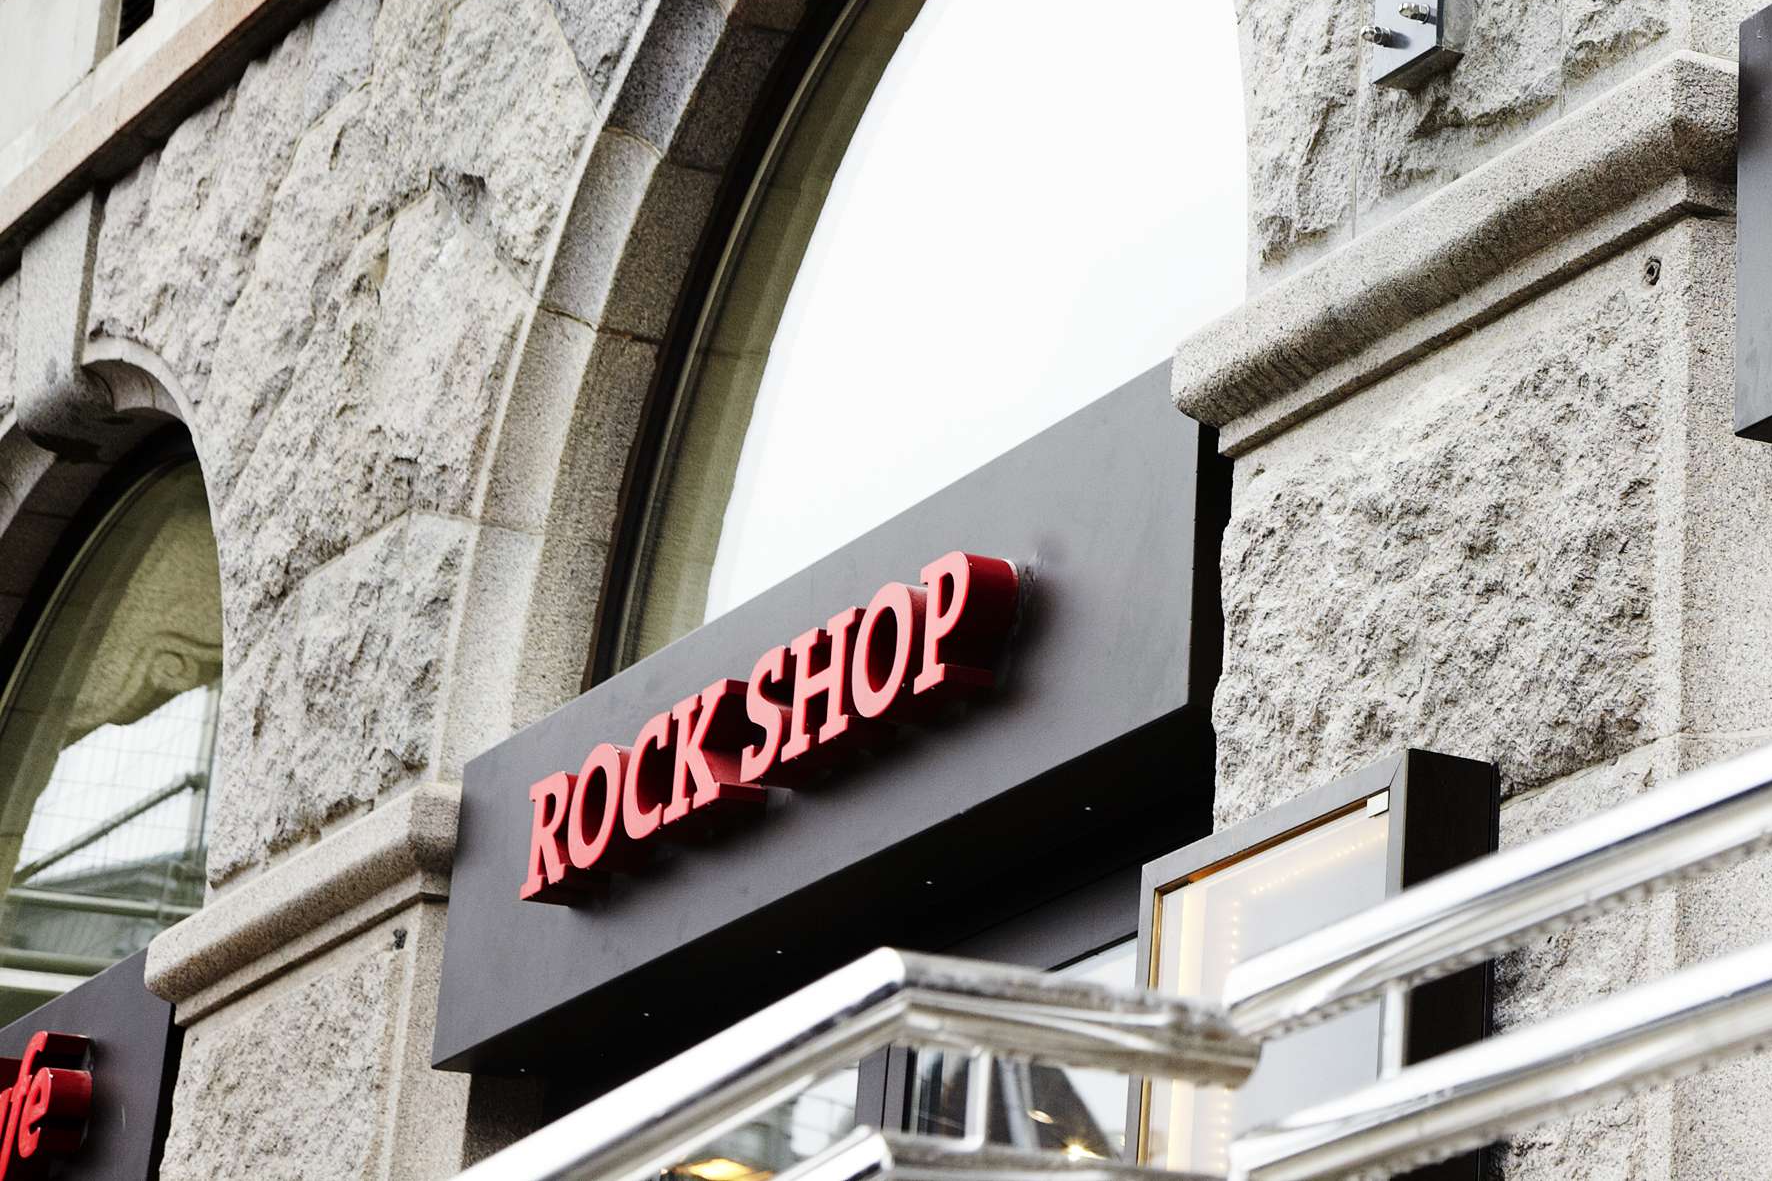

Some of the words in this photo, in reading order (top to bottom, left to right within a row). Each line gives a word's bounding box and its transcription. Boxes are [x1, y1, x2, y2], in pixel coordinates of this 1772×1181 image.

[519, 678, 728, 901] ROCK
[740, 550, 971, 783] SHOP
[0, 1031, 51, 1180] fe
